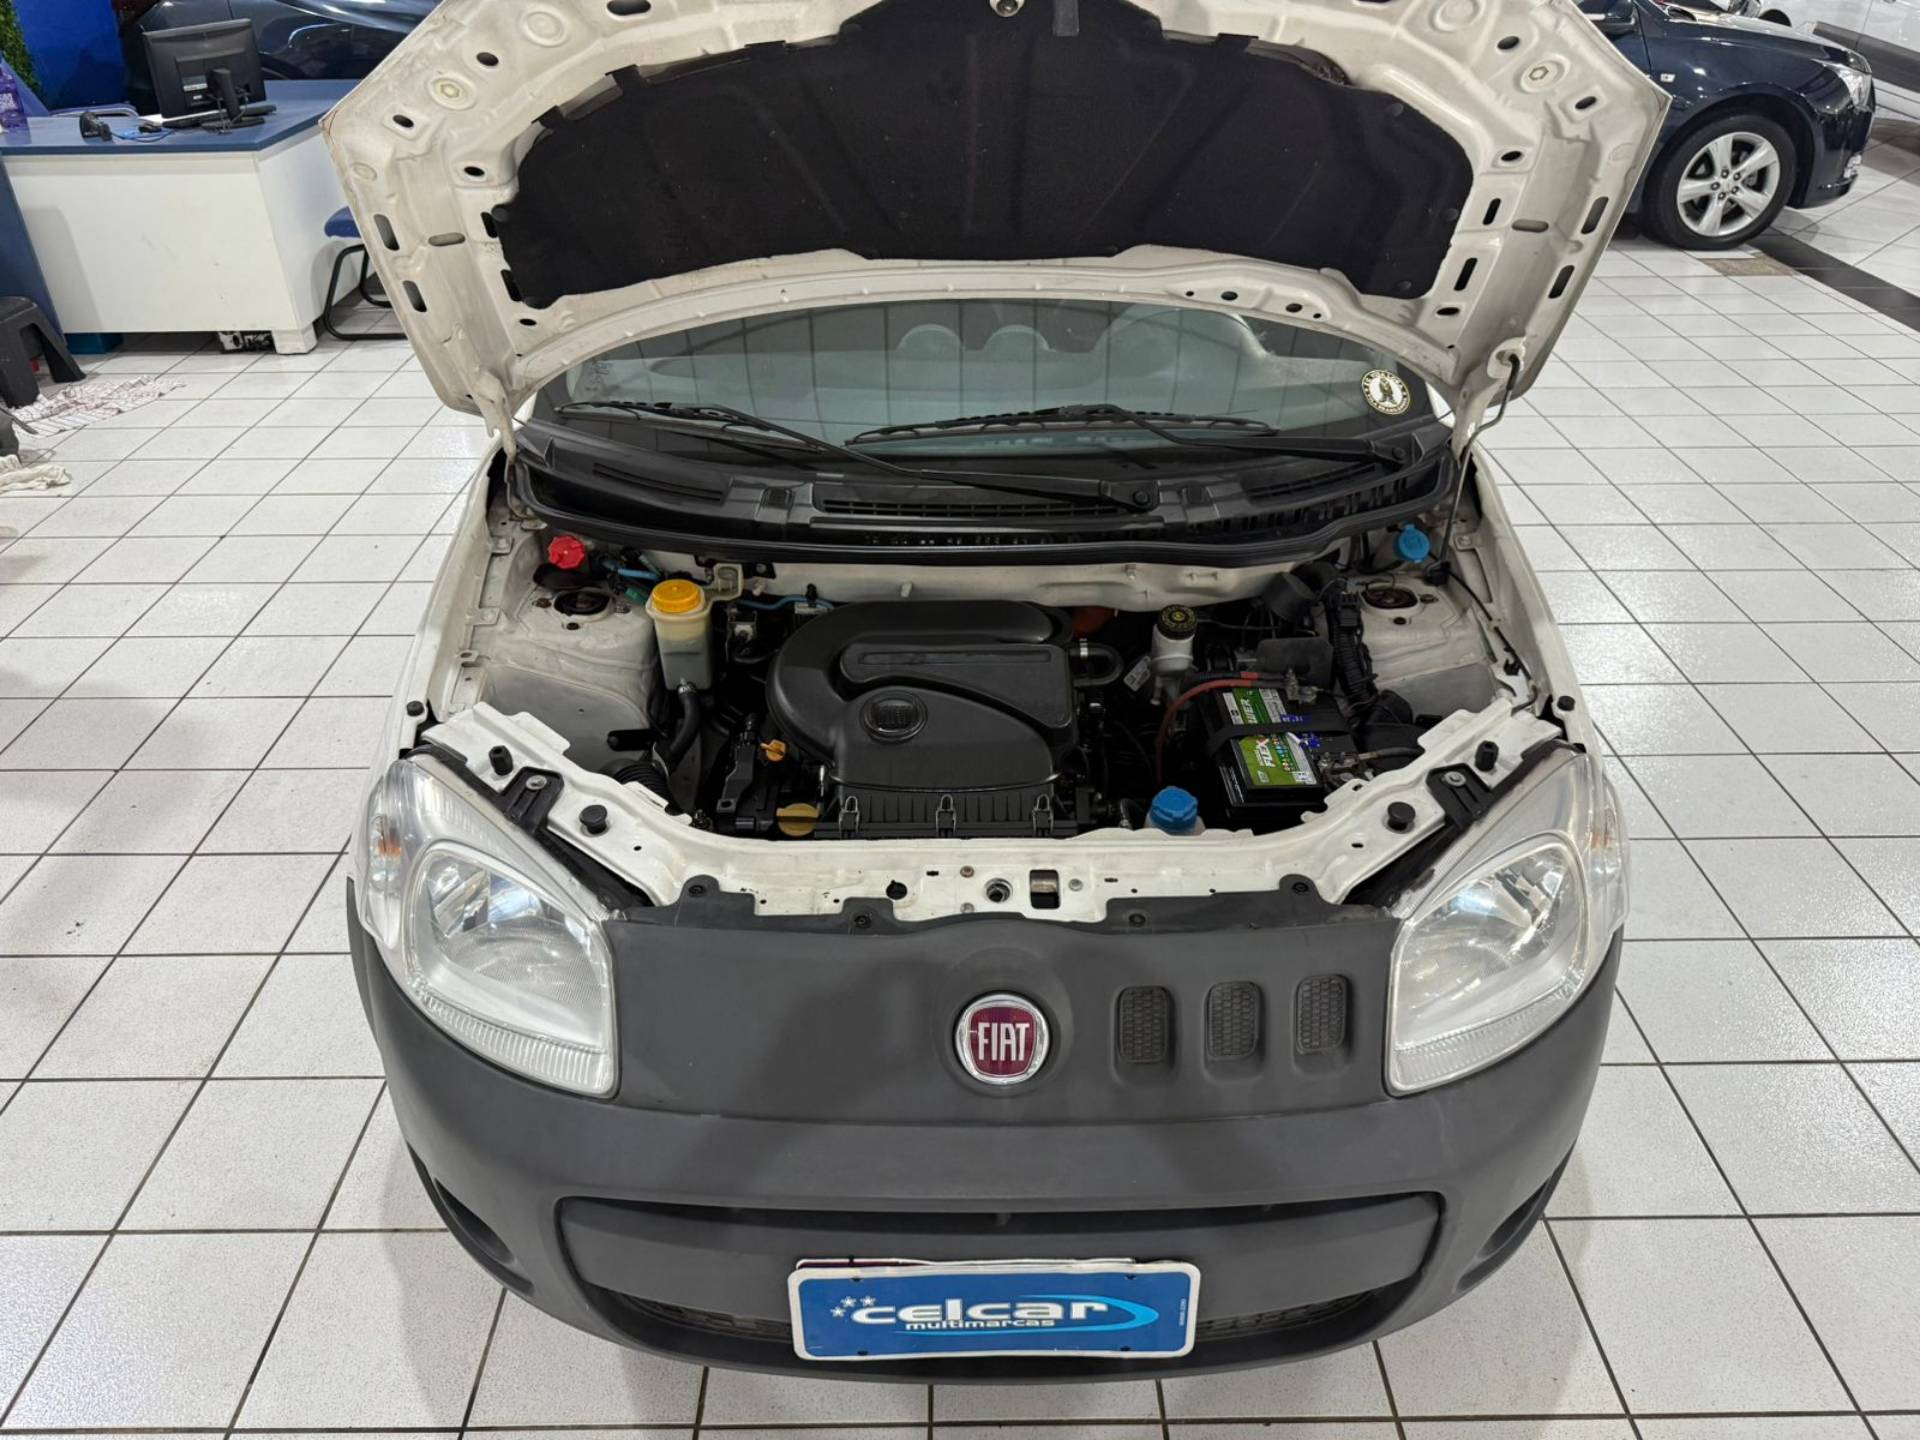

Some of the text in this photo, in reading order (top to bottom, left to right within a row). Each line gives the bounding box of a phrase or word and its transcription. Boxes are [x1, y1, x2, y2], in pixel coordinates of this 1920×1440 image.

[1256, 738, 1277, 767] FLEX
[977, 1022, 1030, 1061] FIAT
[851, 1298, 1108, 1325] celcar
[904, 1318, 1056, 1331] multimarcas
